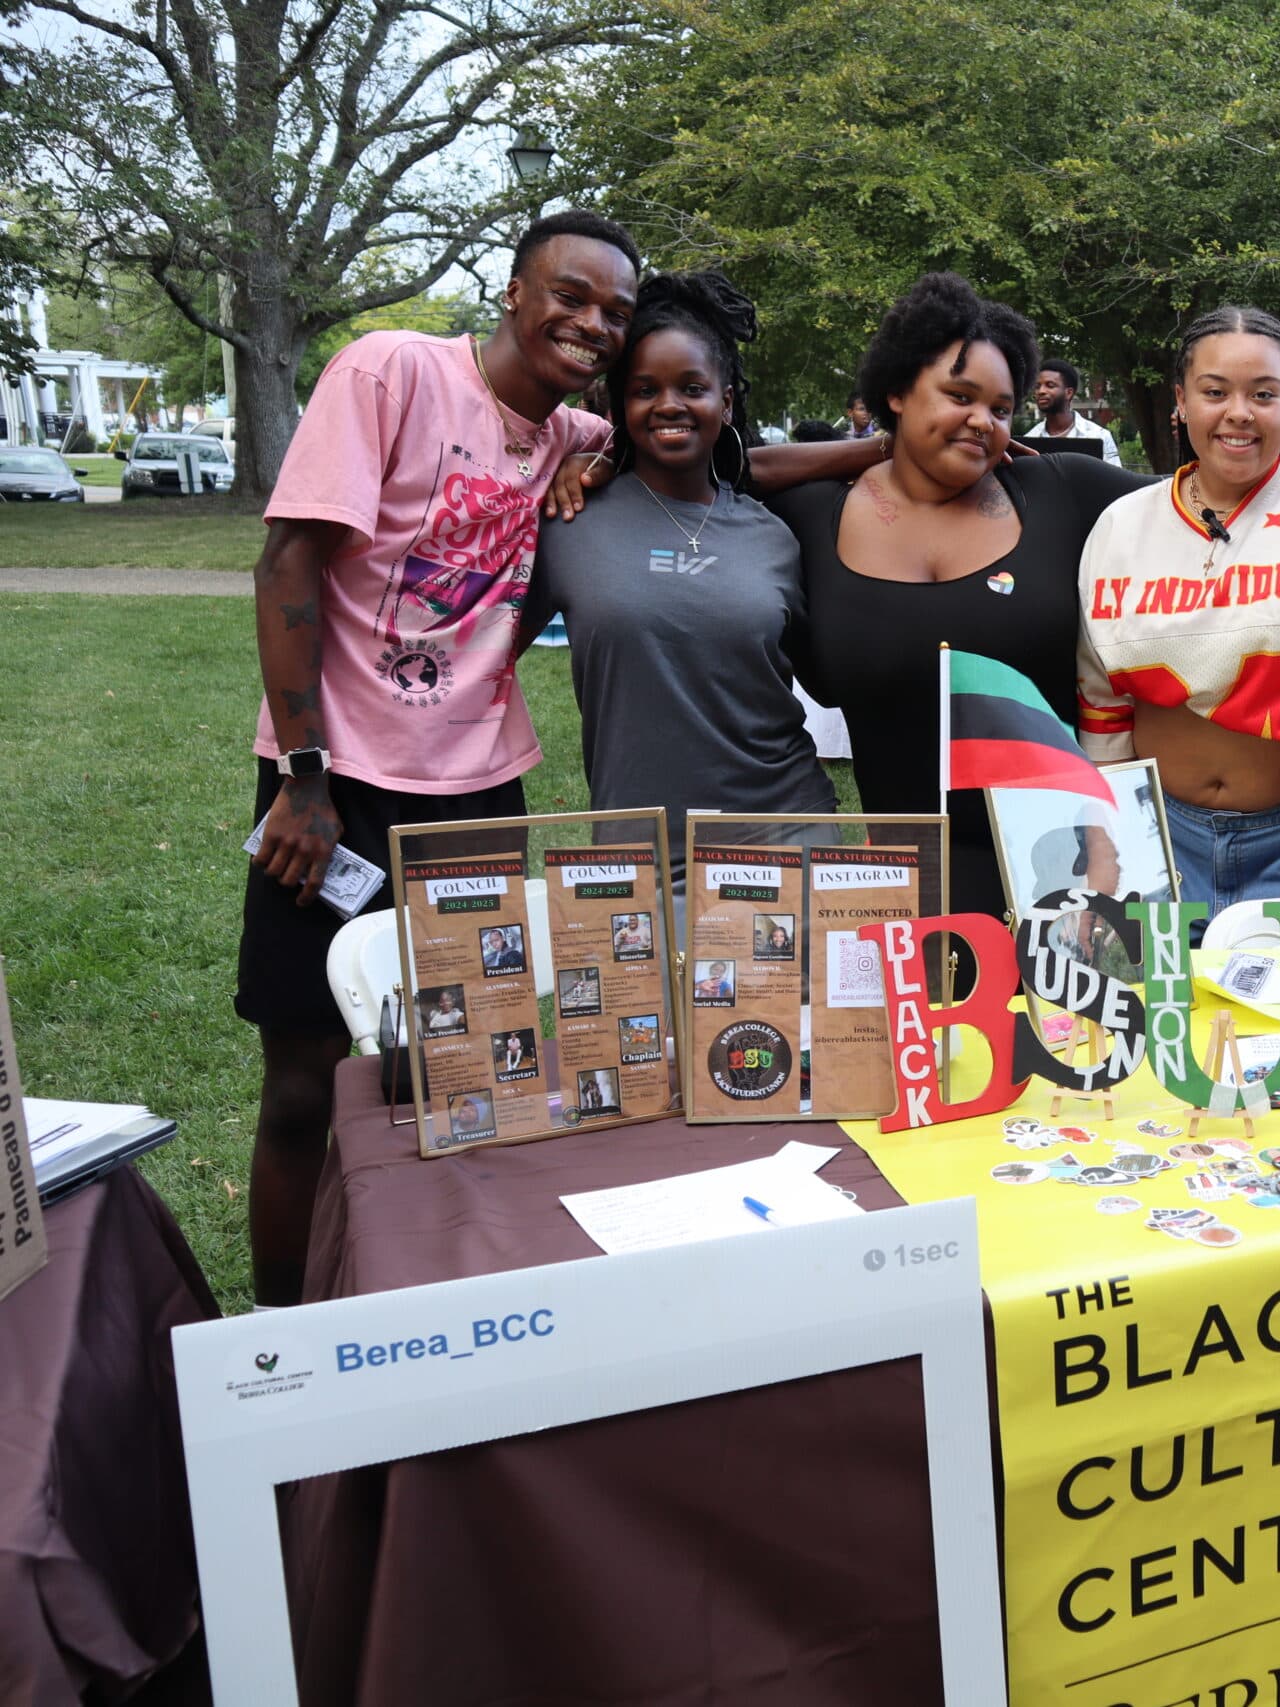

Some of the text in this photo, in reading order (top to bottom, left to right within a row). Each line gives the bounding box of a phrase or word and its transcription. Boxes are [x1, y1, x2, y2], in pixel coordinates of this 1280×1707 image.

[1091, 577, 1131, 620] LY
[546, 853, 653, 863] BLACK STUDENT UNION
[694, 851, 801, 864] BLACK STUDENT UNION
[811, 852, 918, 864] BLACK STUDENT UNION
[406, 863, 522, 877] BLACK STUDENT UNION
[568, 865, 631, 880] COUNCIL
[712, 870, 777, 883] COUNCIL
[819, 869, 904, 883] INSTAGRAM
[433, 877, 499, 897] COUNCIL
[818, 908, 912, 918] STAY CONNECTED
[486, 966, 523, 976] President
[1149, 903, 1188, 1082] UNION
[885, 920, 934, 1128] BLACK
[438, 1028, 466, 1037] President
[720, 1023, 781, 1045] BEREA COLLEGE
[622, 1050, 662, 1063] Chaplain
[498, 1070, 537, 1082] Secretary
[713, 1071, 785, 1097] BLACK STUDENT UNION
[457, 1129, 496, 1142] Treasurer
[893, 1240, 960, 1269] 1sec
[1046, 1275, 1133, 1321] THE
[335, 1308, 556, 1374] Berea_BCC
